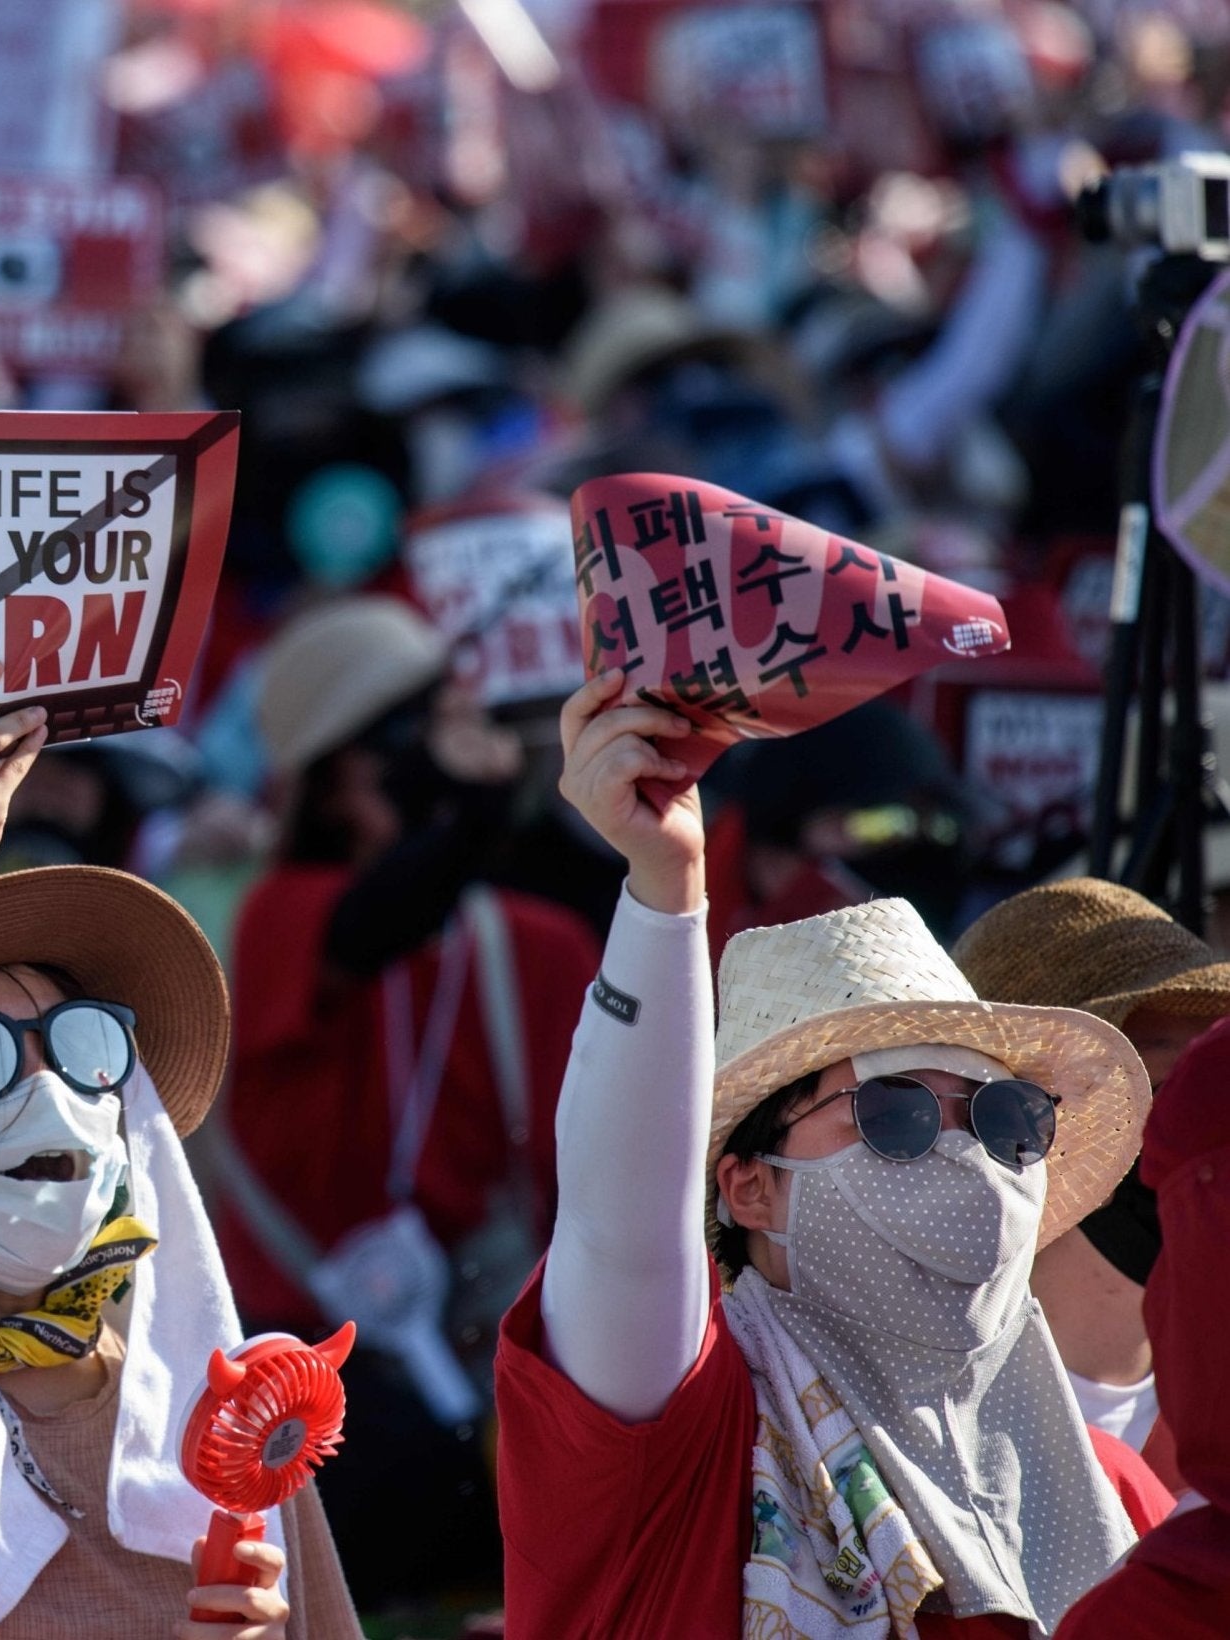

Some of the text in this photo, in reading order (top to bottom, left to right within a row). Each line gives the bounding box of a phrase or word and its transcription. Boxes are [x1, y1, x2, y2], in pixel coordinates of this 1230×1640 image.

[105, 469, 152, 519] IS
[8, 530, 152, 585] YOUR
[637, 592, 918, 734] 벽수사
[606, 995, 629, 1015] TOP
